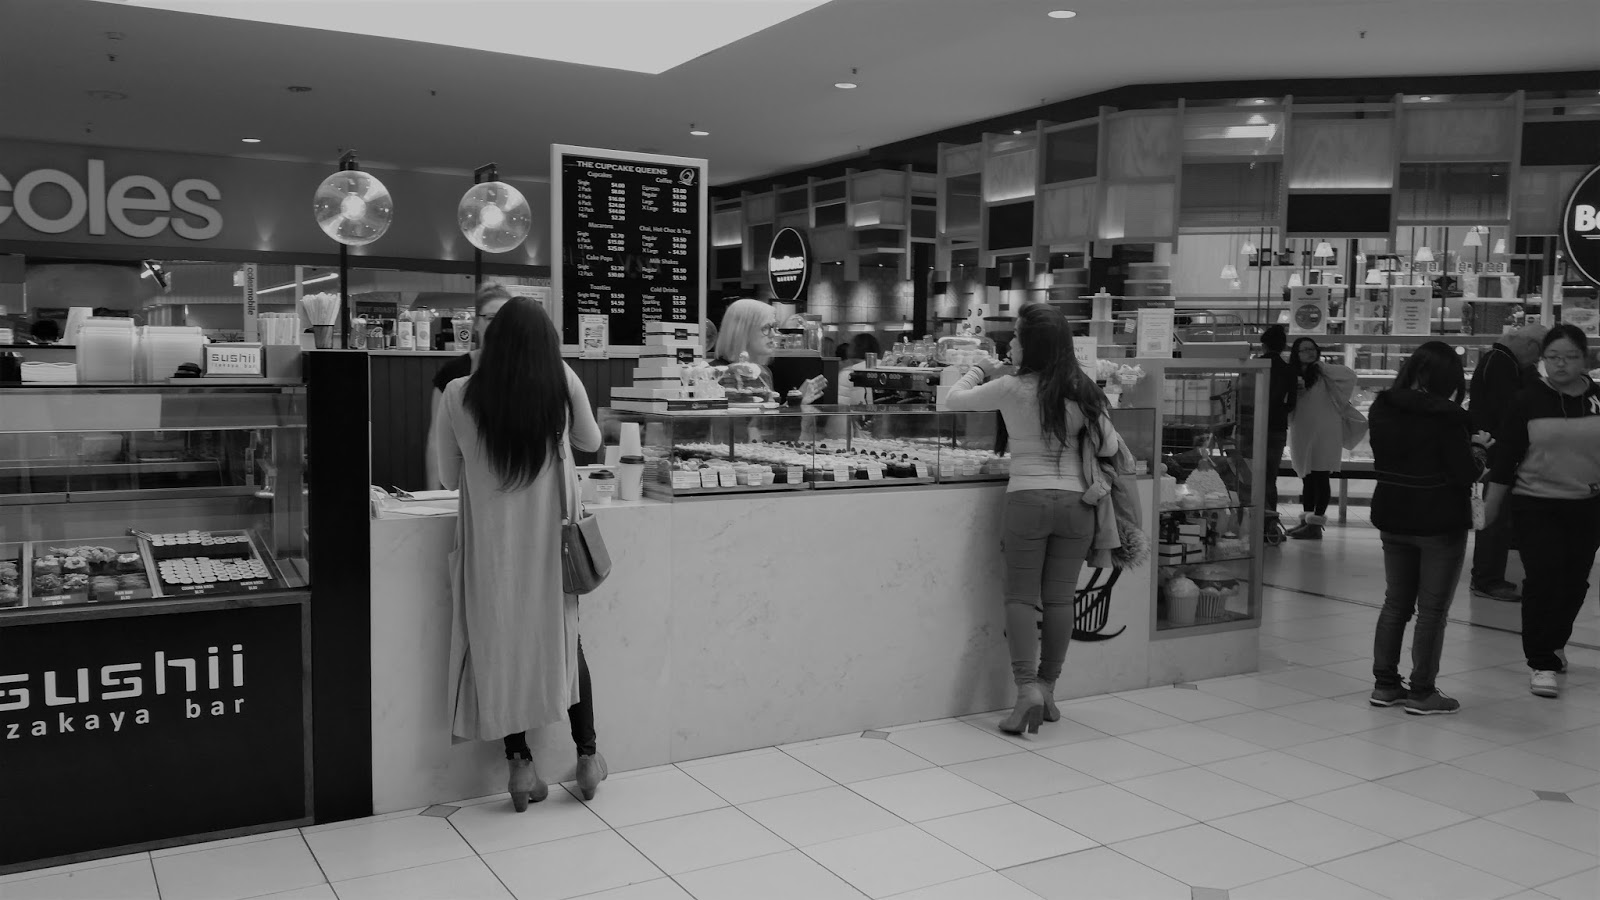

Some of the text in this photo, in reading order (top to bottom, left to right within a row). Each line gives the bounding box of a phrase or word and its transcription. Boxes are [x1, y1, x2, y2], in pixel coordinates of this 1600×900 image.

[576, 161, 668, 176] THE CUPCAKE QUEENS
[587, 171, 613, 179] Cupcakes
[655, 177, 673, 185] Coffee
[577, 179, 591, 187] Single
[0, 159, 223, 240] oles
[211, 353, 256, 363] sushii
[0, 644, 244, 712] sushii
[186, 698, 245, 719] bar
